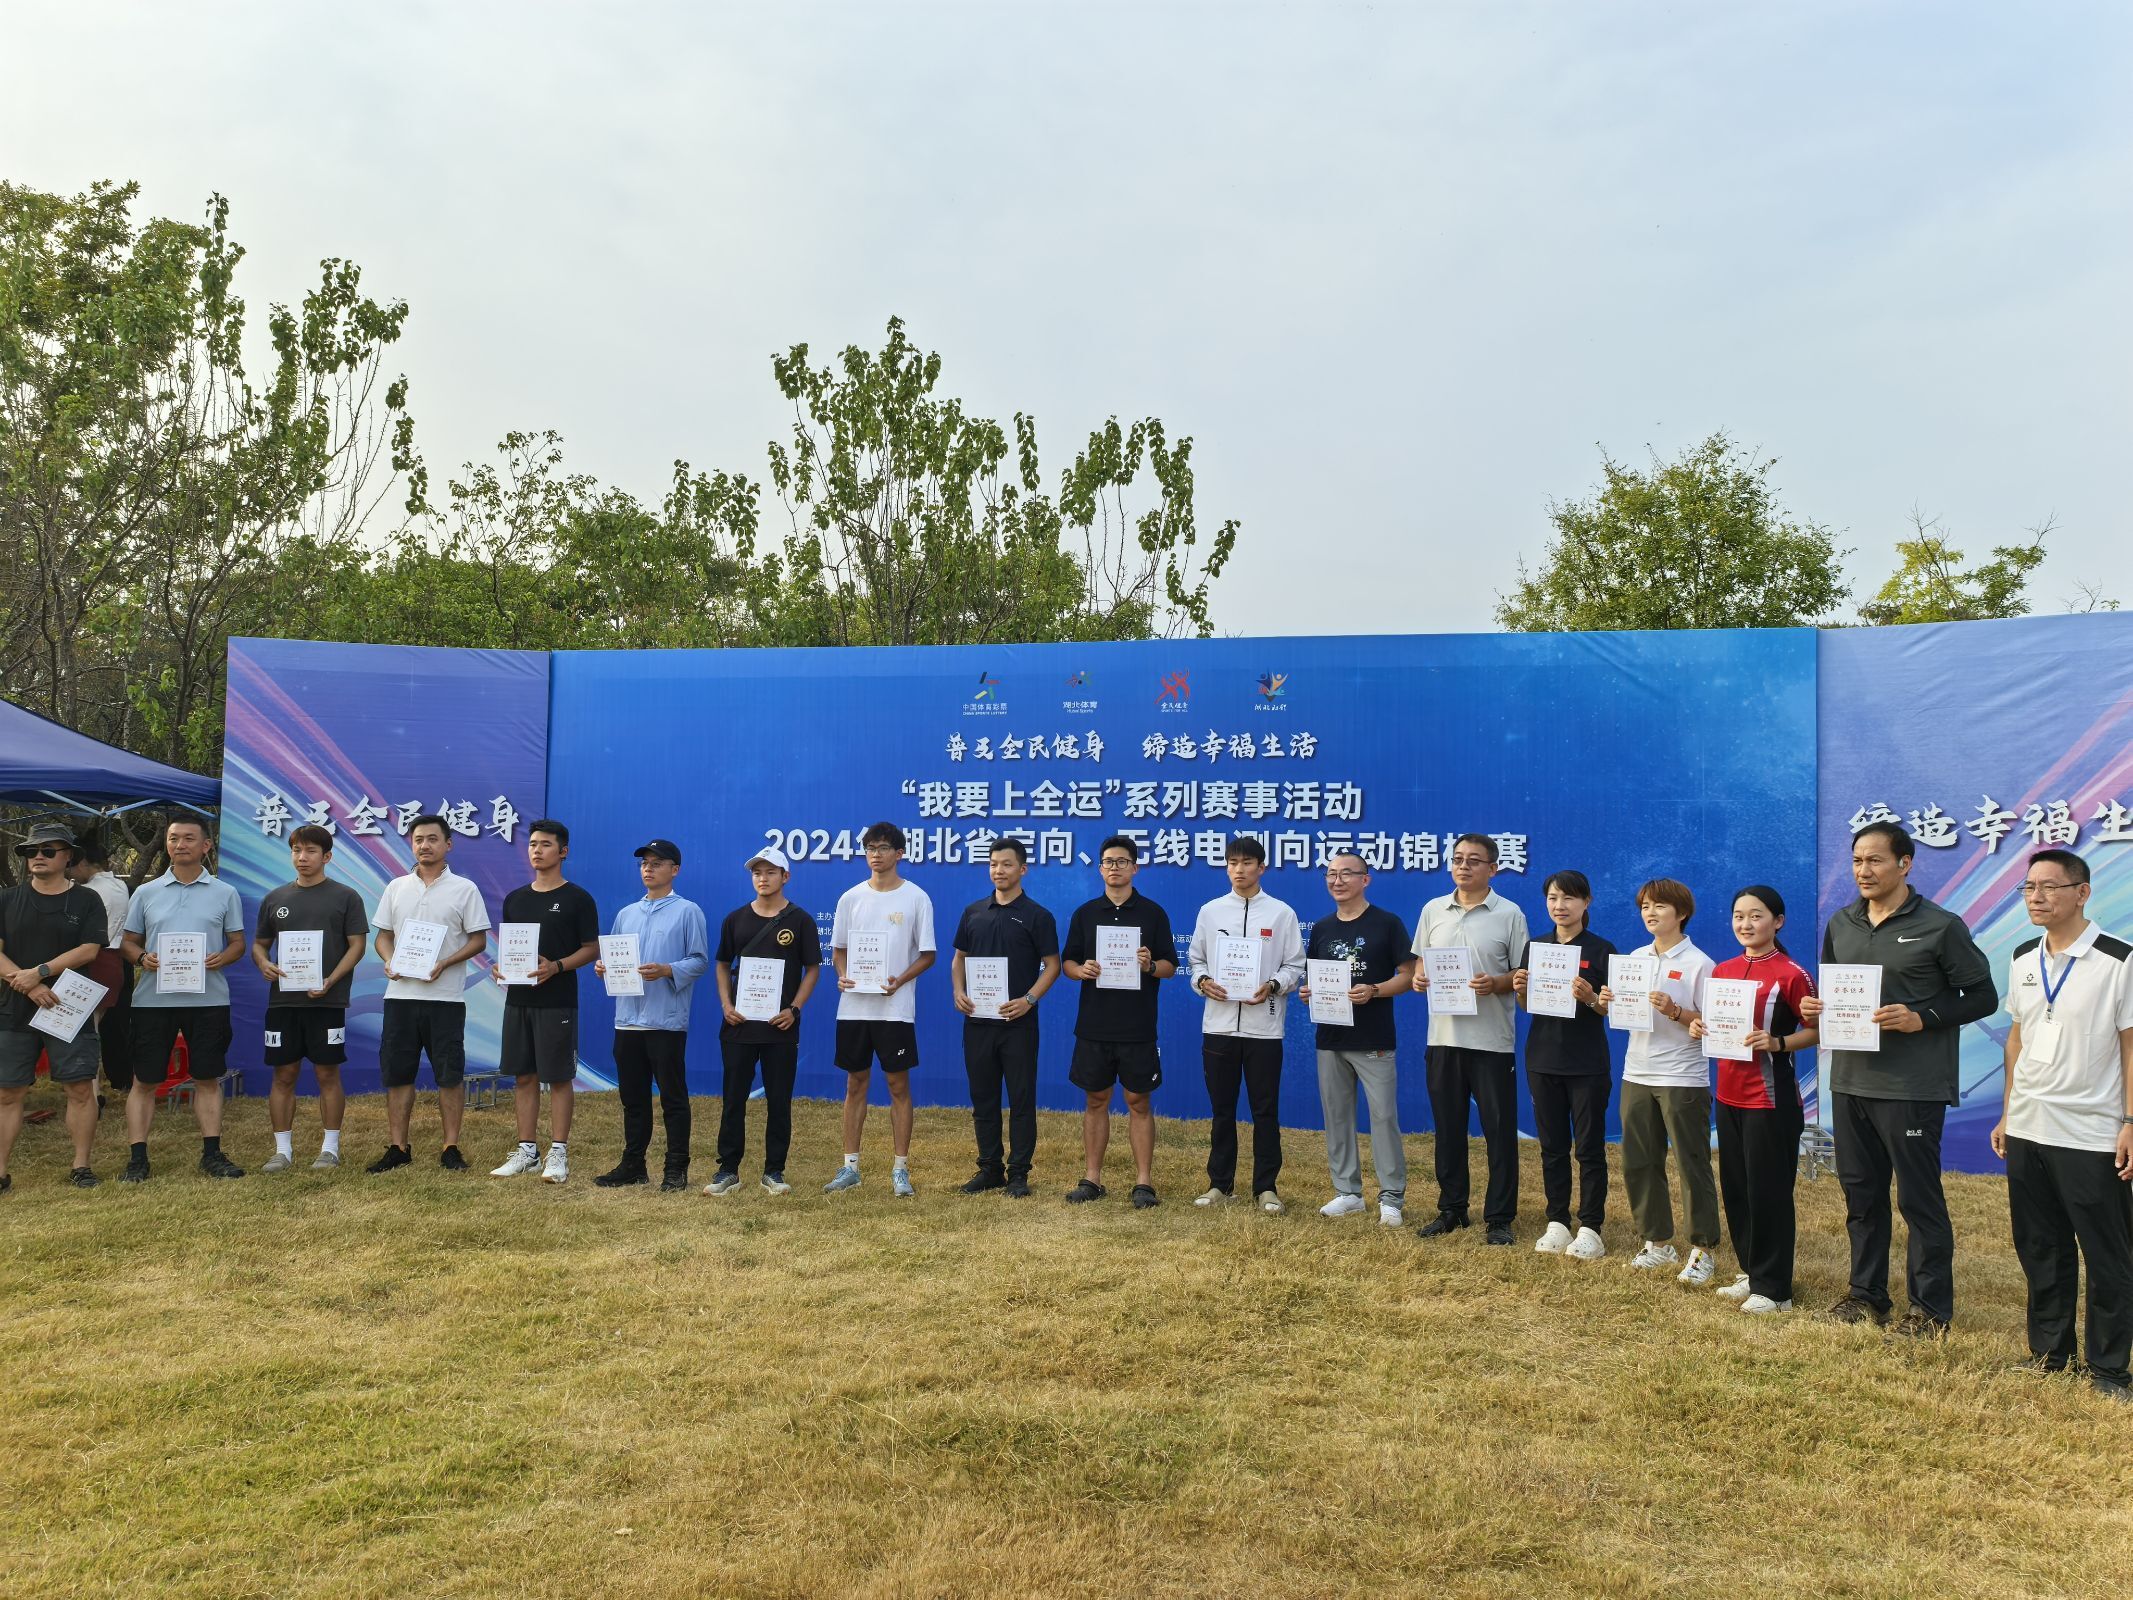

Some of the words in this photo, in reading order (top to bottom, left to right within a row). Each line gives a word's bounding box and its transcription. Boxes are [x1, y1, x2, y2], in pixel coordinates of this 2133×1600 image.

[963, 702, 1008, 711] 中国体育彩票
[1063, 701, 1098, 709] 湖北体育
[945, 730, 1104, 762] 普及全民健身
[1142, 729, 1319, 763] 缔造幸福生活
[816, 911, 836, 921] 主办
